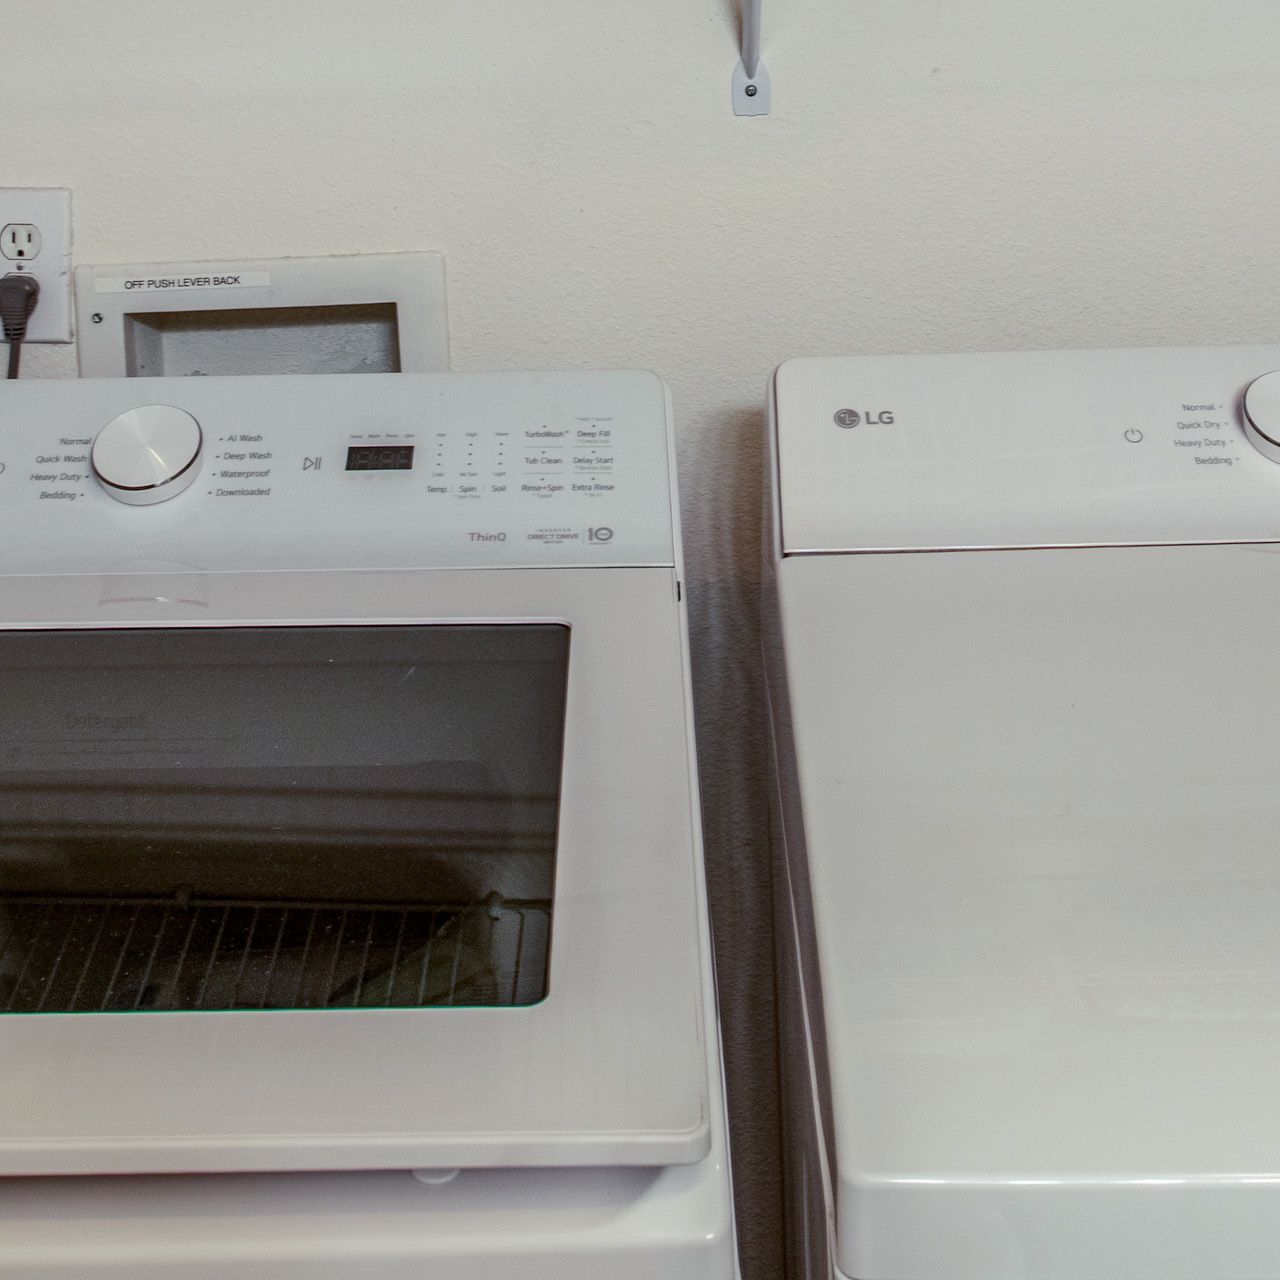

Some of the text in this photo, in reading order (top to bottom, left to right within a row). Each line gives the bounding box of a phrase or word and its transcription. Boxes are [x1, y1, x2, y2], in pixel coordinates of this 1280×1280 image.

[124, 276, 241, 290] OFF PUSH LEVER BACK
[864, 410, 895, 425] LG
[1176, 421, 1221, 430] Quick Dry
[577, 430, 597, 438] Deep
[60, 437, 92, 445] Normal
[1174, 439, 1226, 448] Heavy Duty
[35, 455, 61, 464] Quick
[223, 452, 272, 461] Deep Wash
[573, 457, 594, 465] Delay
[1195, 457, 1232, 465] Bedding
[30, 472, 82, 482] Heavy Duty
[220, 470, 270, 479] Waterproof
[459, 485, 477, 494] Spin
[572, 483, 615, 491] Extra Rinse
[40, 491, 76, 501] Bedding
[216, 488, 271, 497] Downloaded
[469, 532, 506, 542] ThinQ
